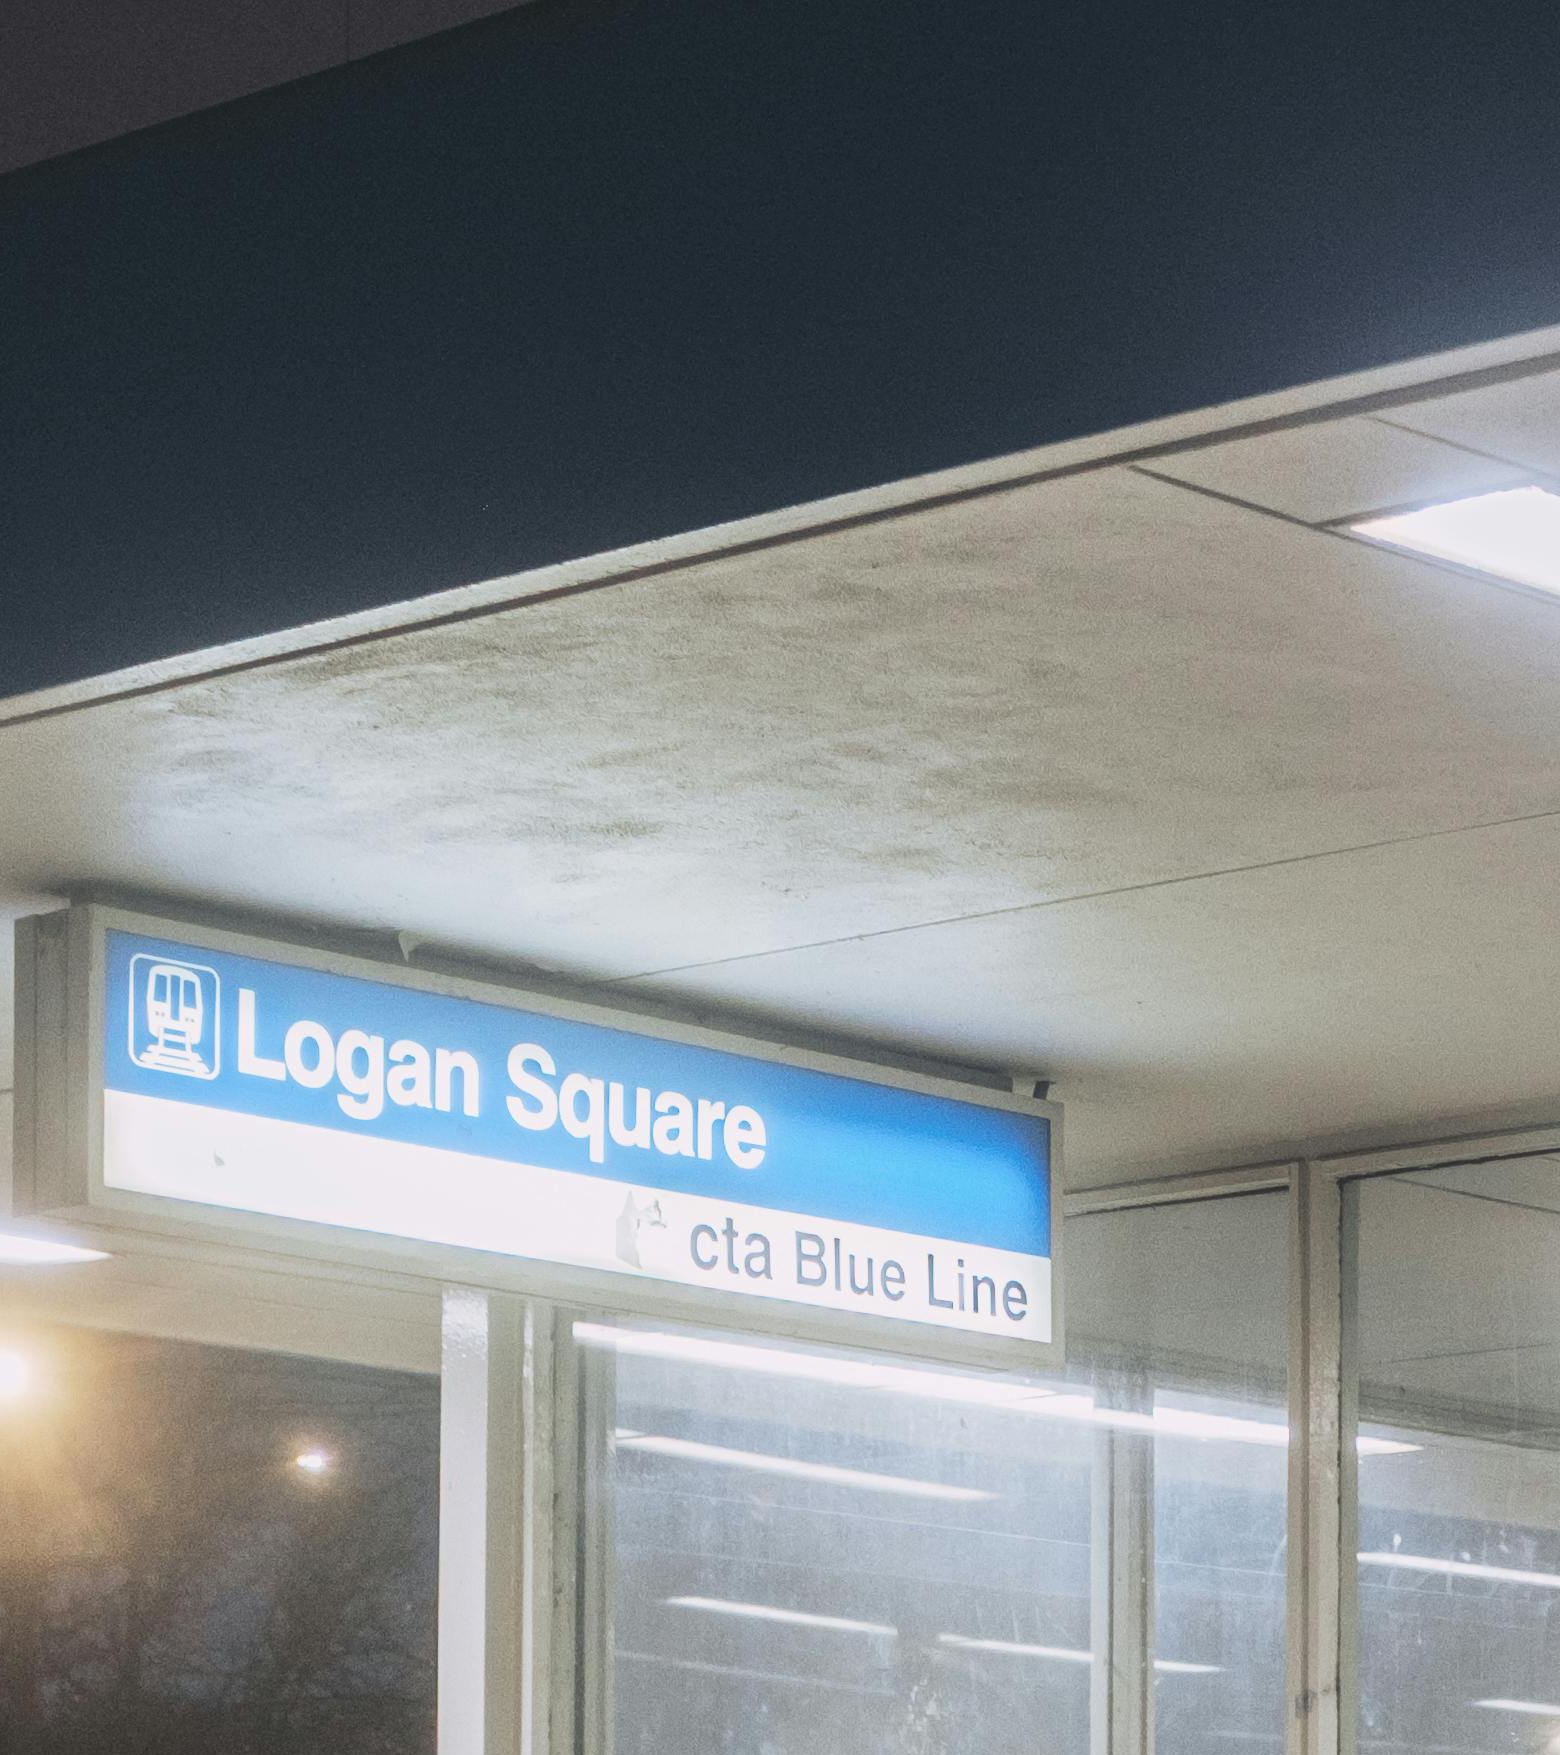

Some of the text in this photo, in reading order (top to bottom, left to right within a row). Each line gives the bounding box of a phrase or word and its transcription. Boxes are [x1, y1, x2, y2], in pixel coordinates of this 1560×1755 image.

[237, 987, 767, 1168] Logan Square
[689, 1217, 1029, 1321] cta Blue Line
